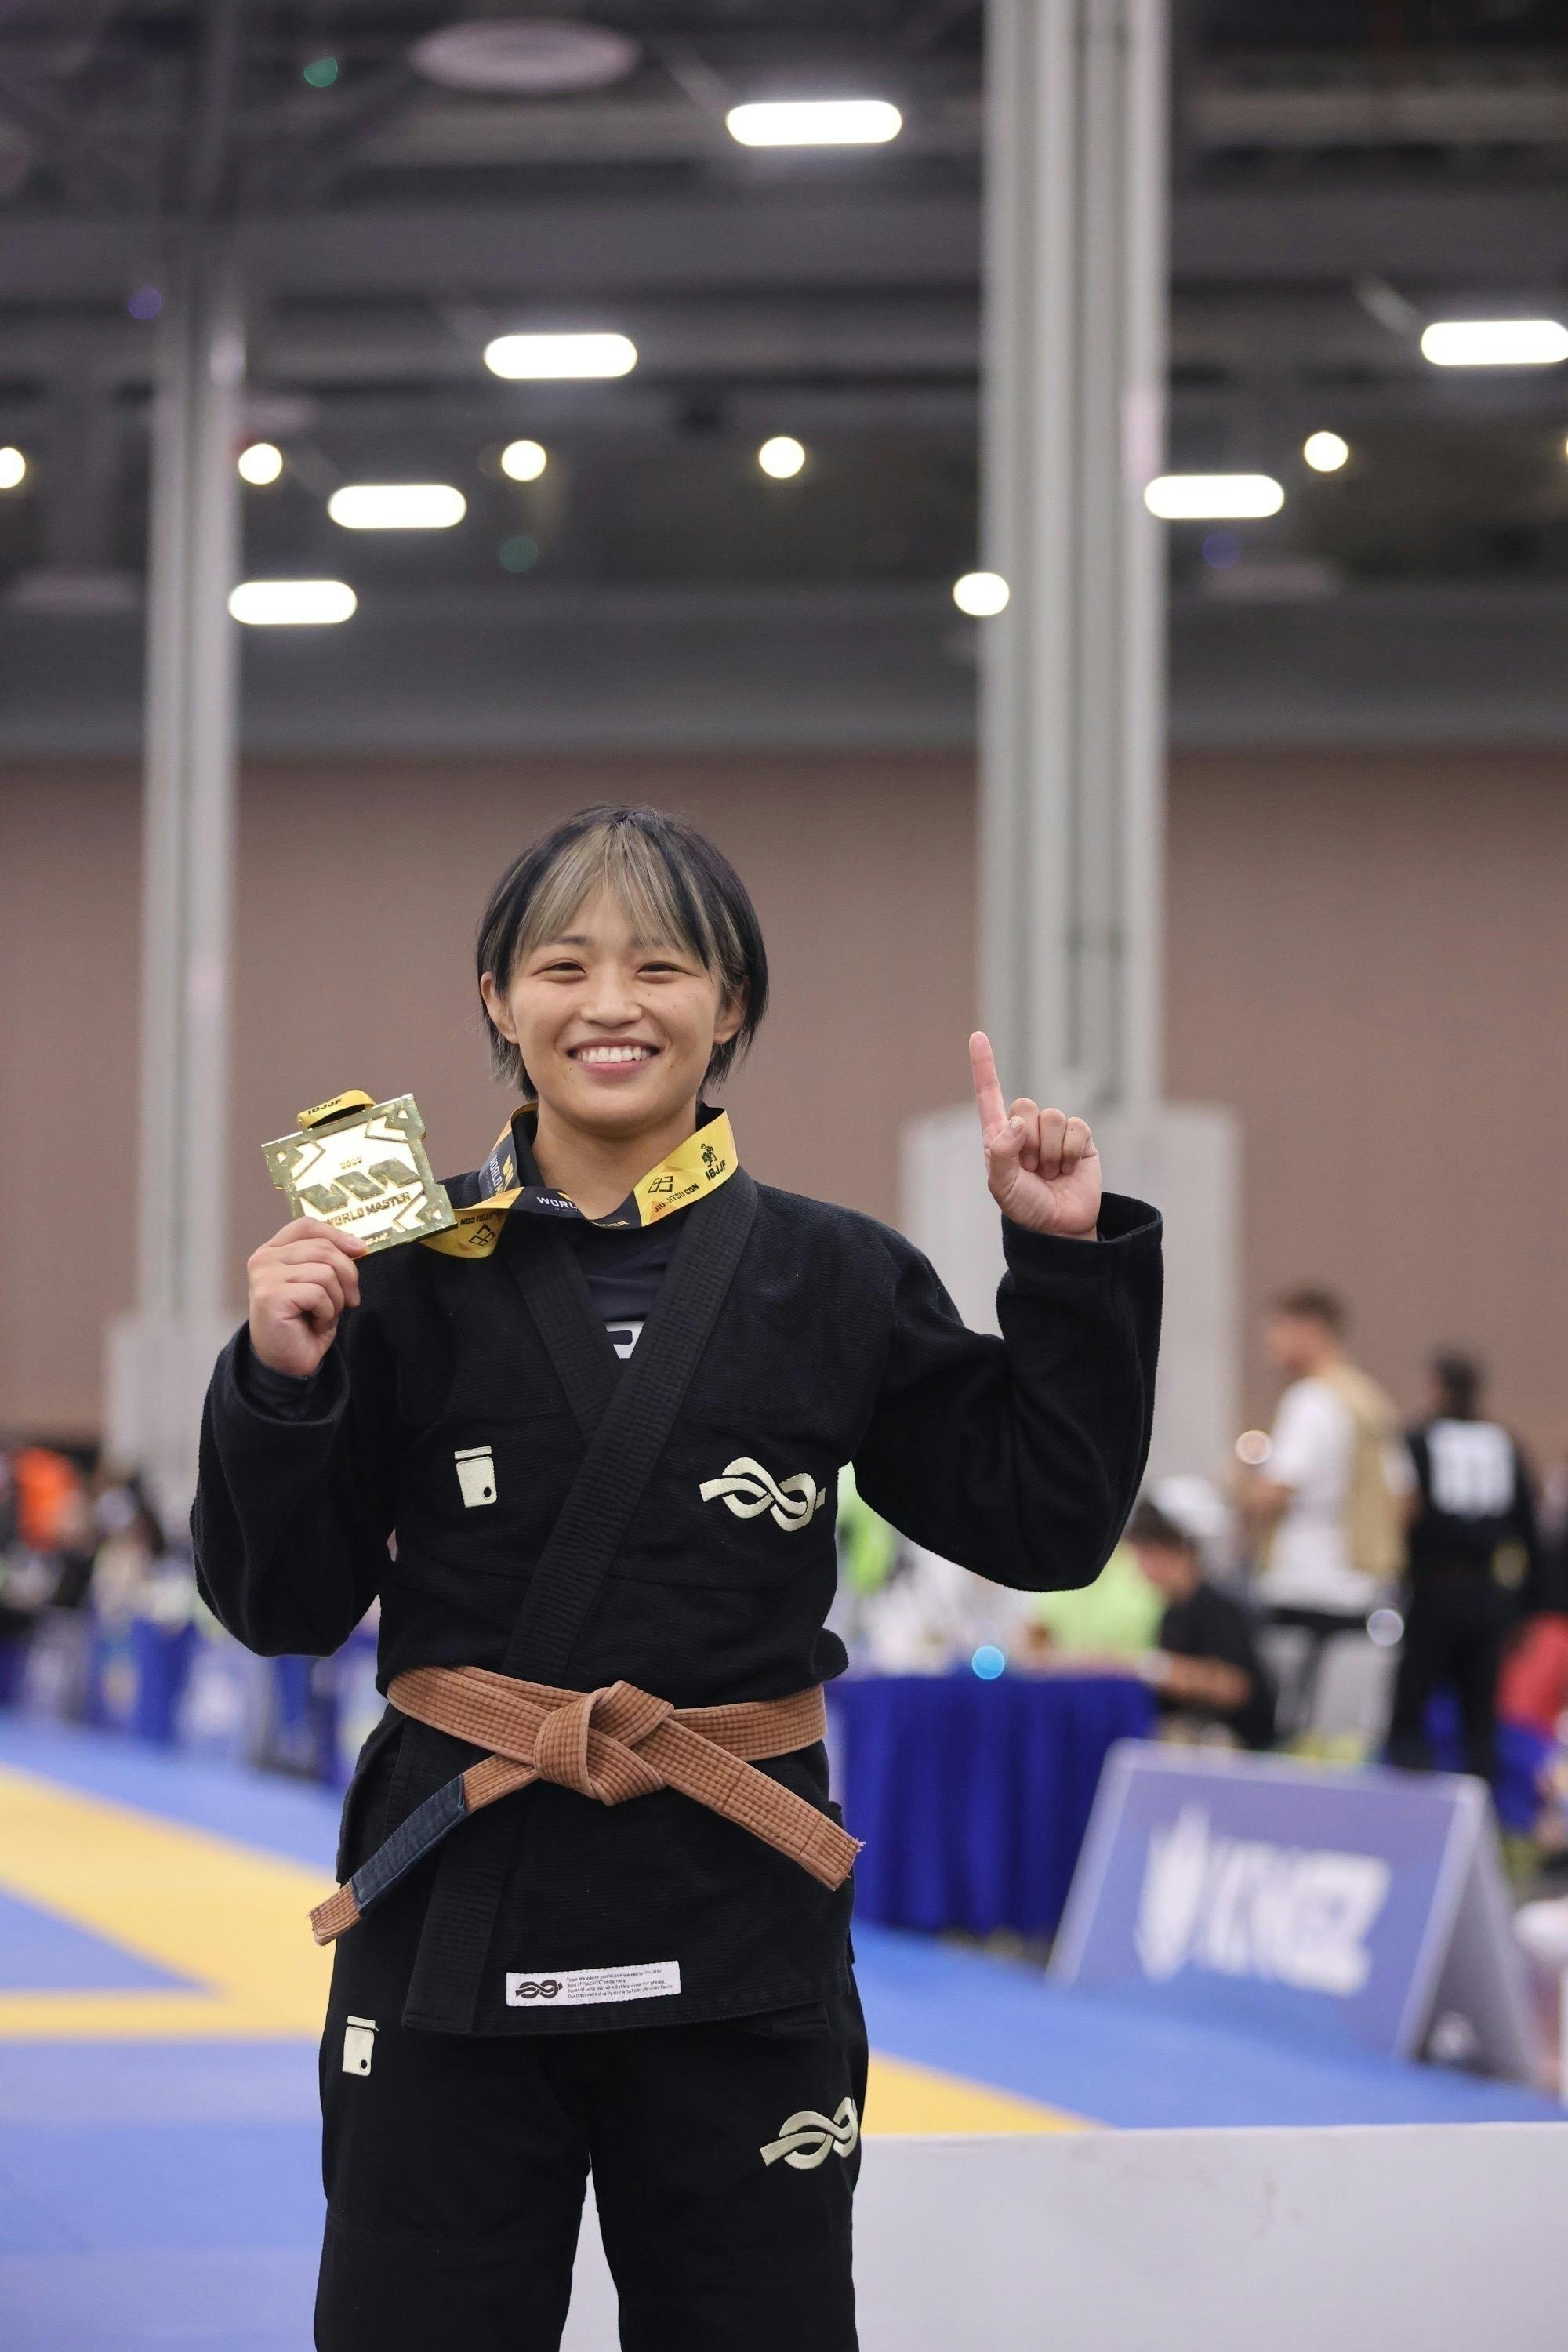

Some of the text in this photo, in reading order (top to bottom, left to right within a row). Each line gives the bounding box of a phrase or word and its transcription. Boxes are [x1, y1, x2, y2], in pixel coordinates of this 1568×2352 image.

[308, 1098, 342, 1115] IBJJF
[490, 1154, 503, 1187] WORLD
[705, 1159, 726, 1181] IBJJF
[325, 1191, 412, 1226] WORLD MASTER
[536, 1196, 578, 1210] WORL
[653, 1183, 700, 1212] JIU-JITSU CON
